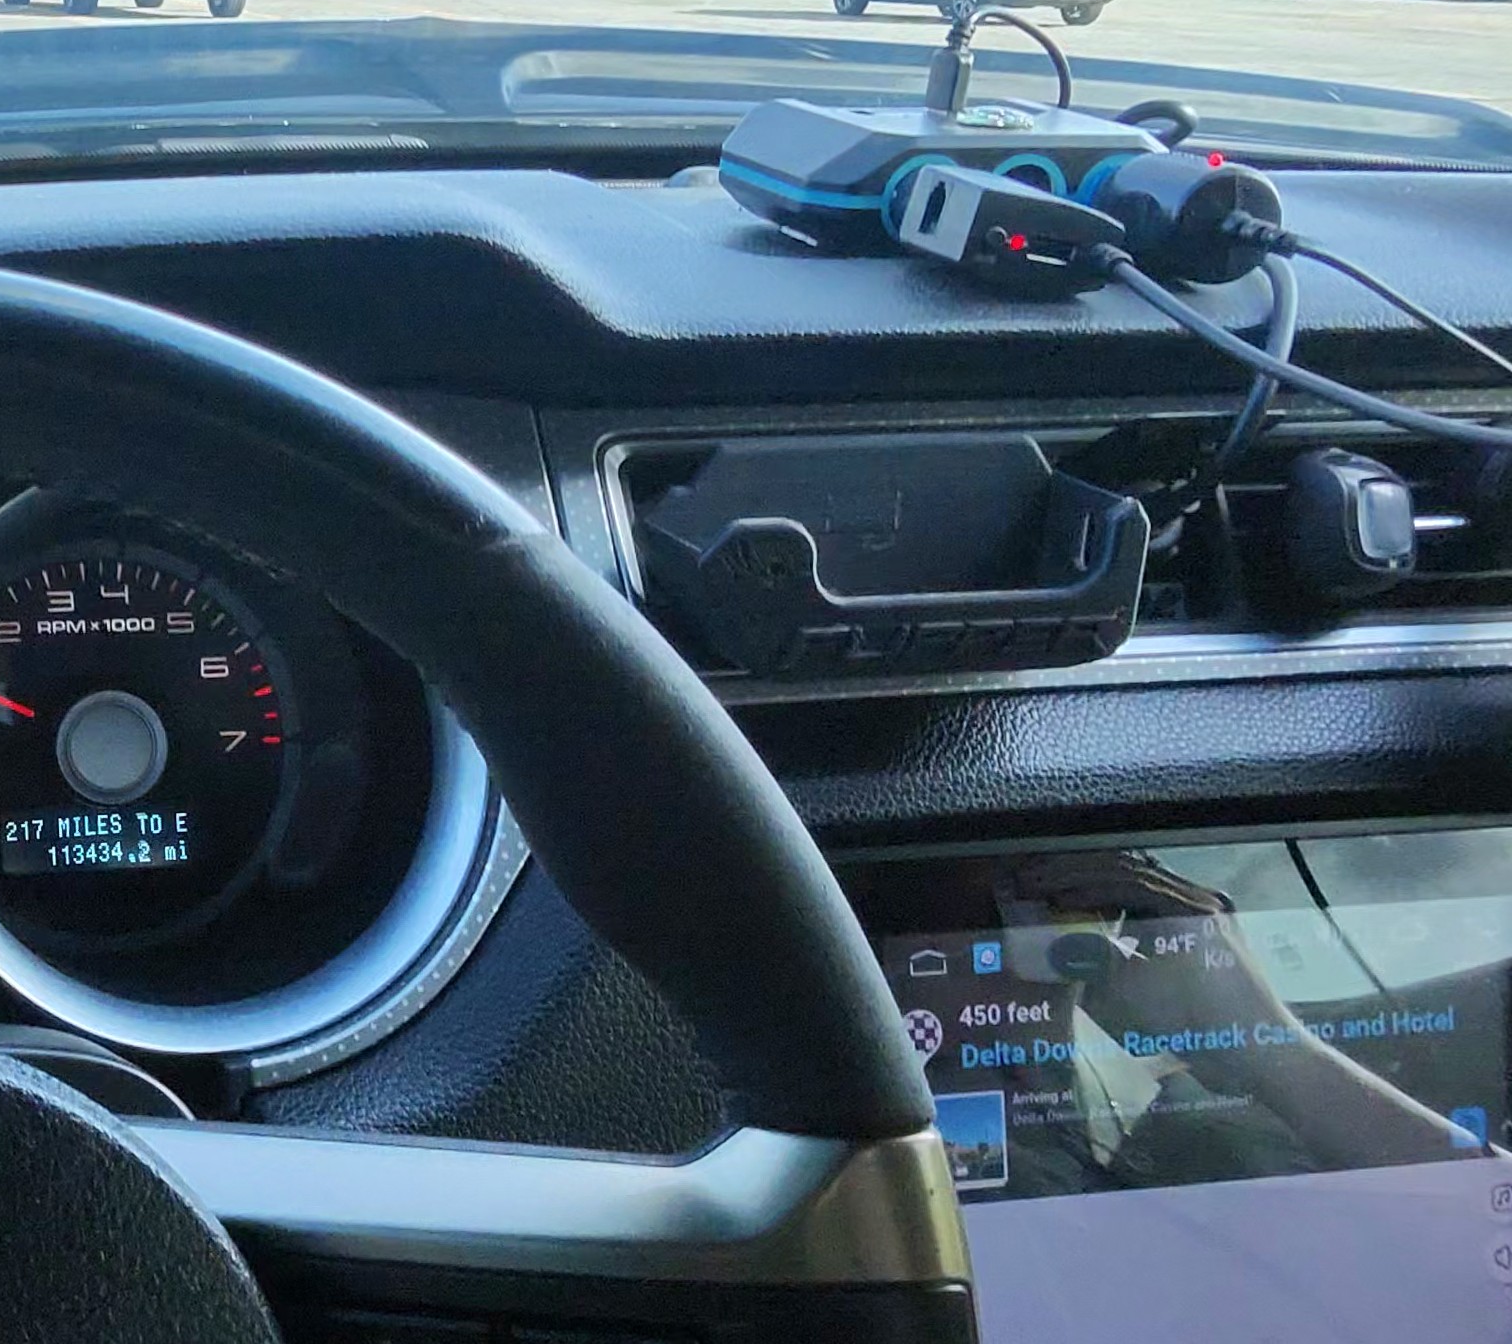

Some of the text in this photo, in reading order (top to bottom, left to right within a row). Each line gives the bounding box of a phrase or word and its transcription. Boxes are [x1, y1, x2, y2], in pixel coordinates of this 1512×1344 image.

[47, 591, 75, 612] 3
[100, 584, 129, 605] 4
[166, 613, 195, 635] 5
[201, 657, 229, 678] 6
[219, 731, 247, 752] 7
[5, 813, 189, 843] 217 MILES TO E
[165, 842, 189, 861] mi
[959, 1001, 1051, 1027] 450 feet
[960, 1040, 1027, 1068] Delta
[1123, 1022, 1246, 1055] Racetrack
[1253, 1019, 1336, 1046] Casno
[1342, 1011, 1385, 1038] and
[1392, 1005, 1456, 1035] Hotel
